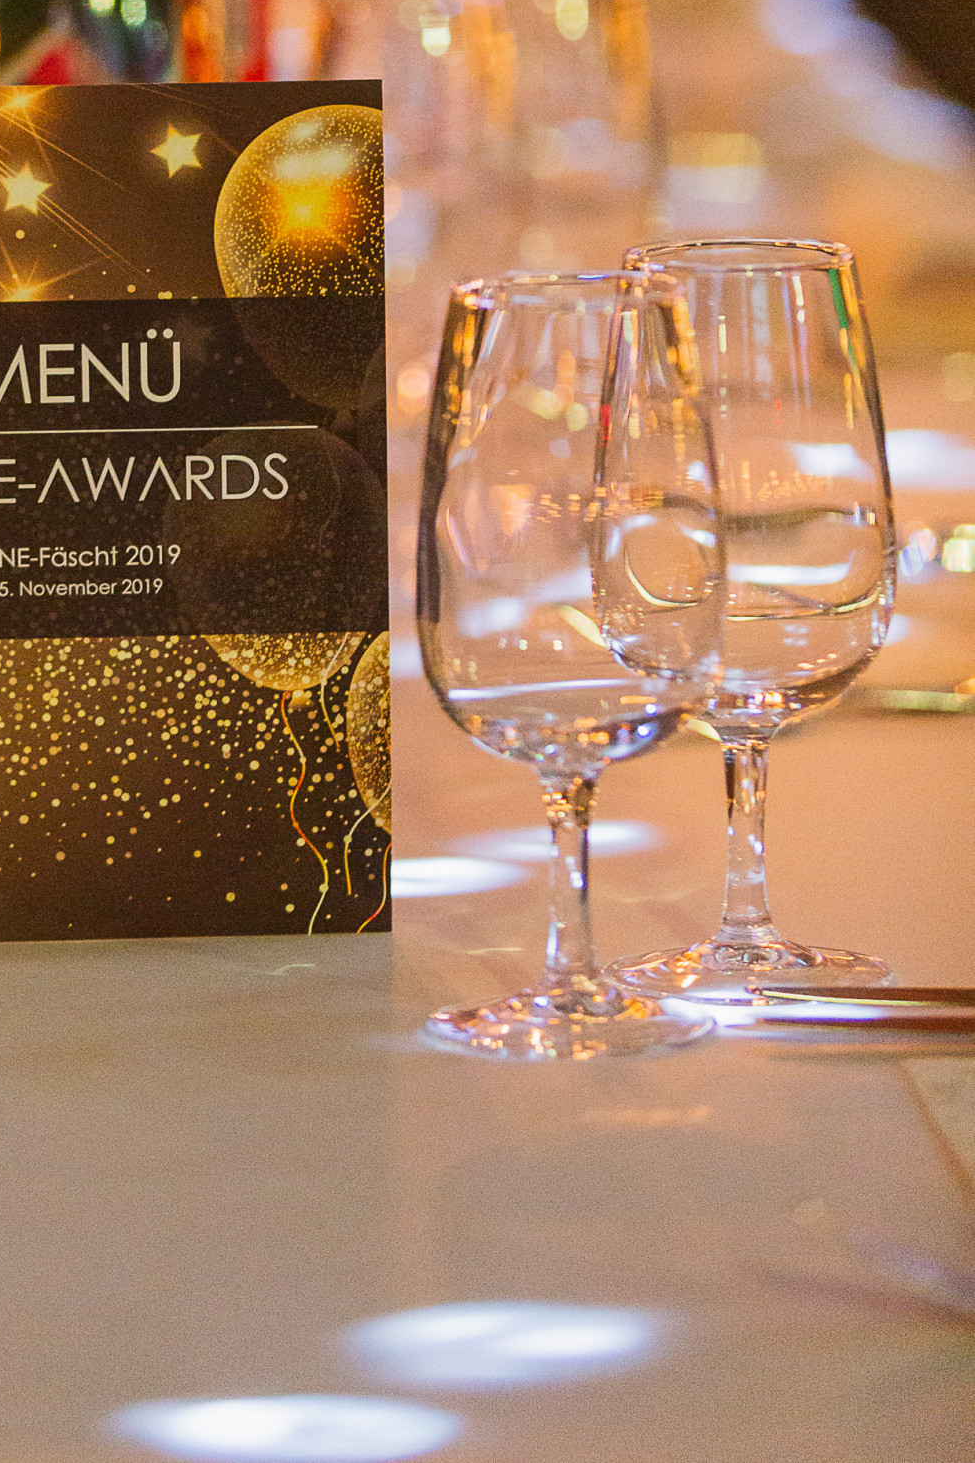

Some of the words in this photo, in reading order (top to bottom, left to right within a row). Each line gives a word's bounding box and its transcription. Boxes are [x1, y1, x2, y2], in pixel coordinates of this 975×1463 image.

[125, 544, 182, 567] 2019
[19, 579, 117, 597] November
[121, 578, 164, 596] 2019
